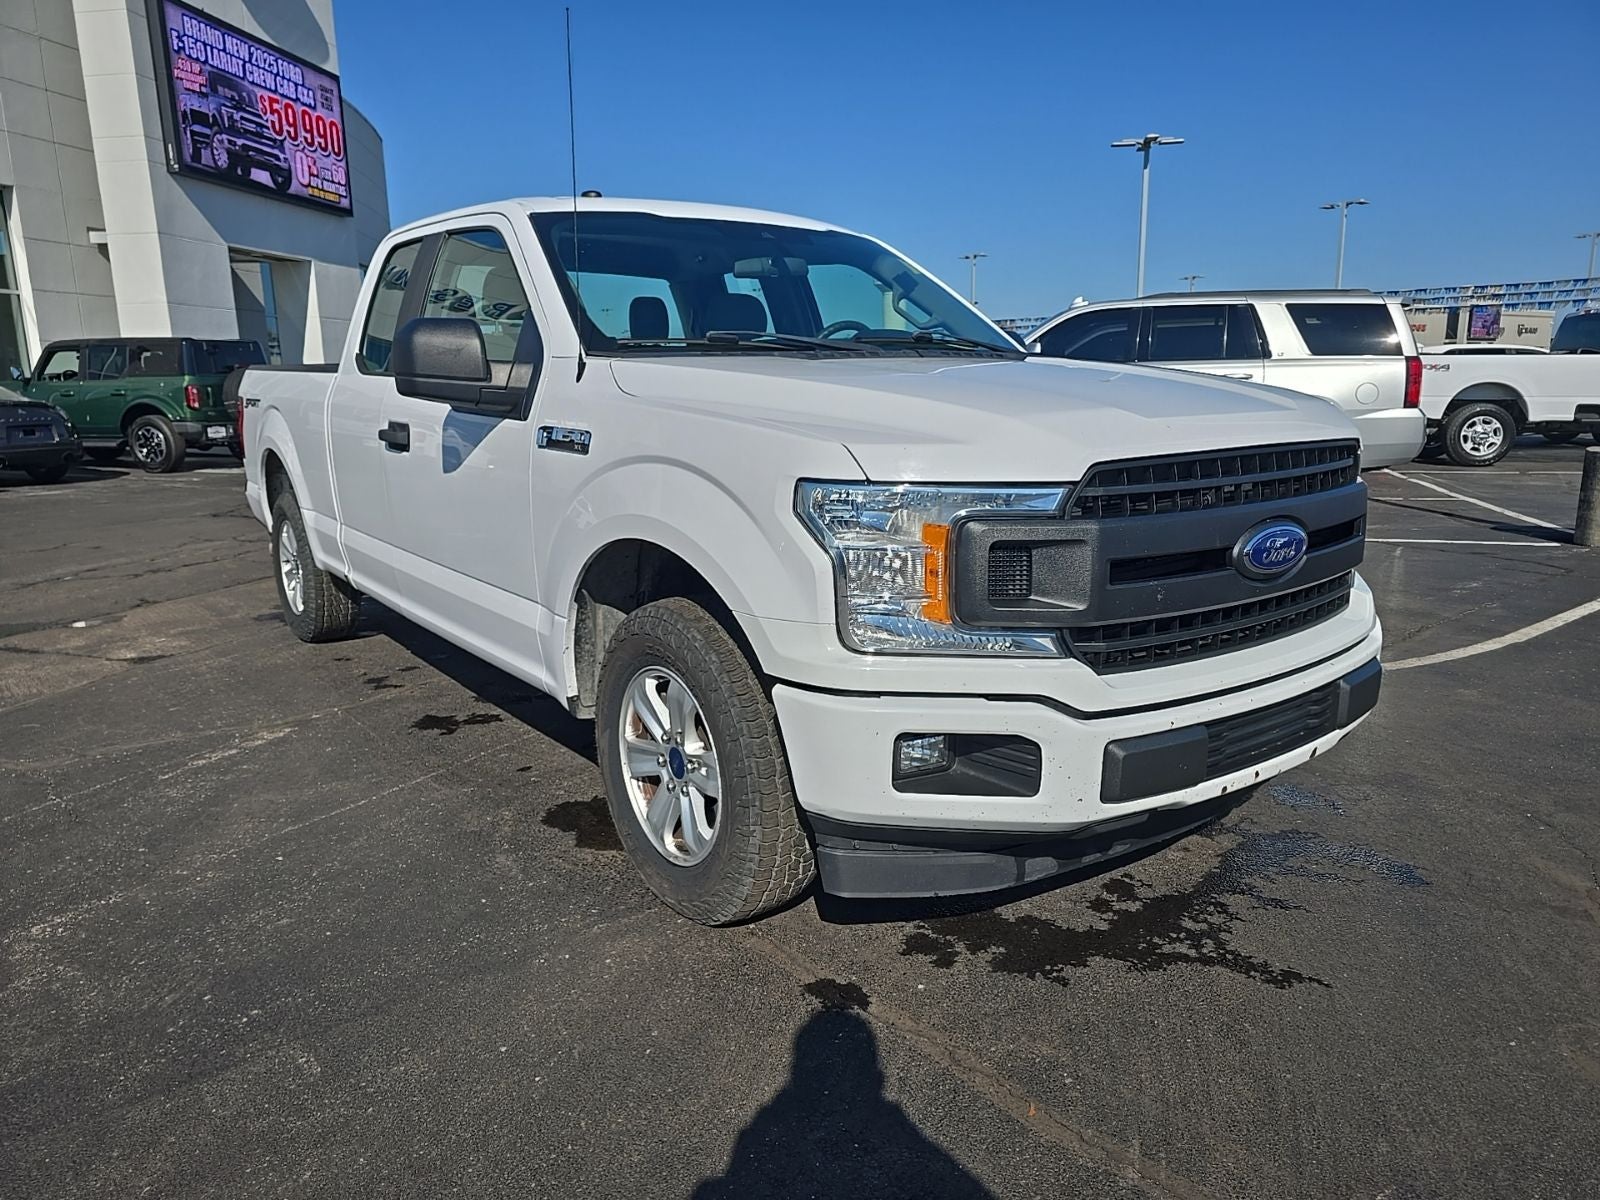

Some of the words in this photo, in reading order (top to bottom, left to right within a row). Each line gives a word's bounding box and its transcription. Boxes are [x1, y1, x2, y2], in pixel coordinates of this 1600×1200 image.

[170, 29, 207, 62] F-150
[206, 45, 245, 78] LARIAT
[245, 62, 277, 91] CREW
[275, 75, 297, 99] CAB
[182, 15, 225, 51] BRAND
[224, 33, 250, 62] NEW
[250, 45, 278, 75] 2025
[277, 58, 304, 85] FORD
[331, 163, 347, 186] 60
[1262, 537, 1297, 563] Ford
